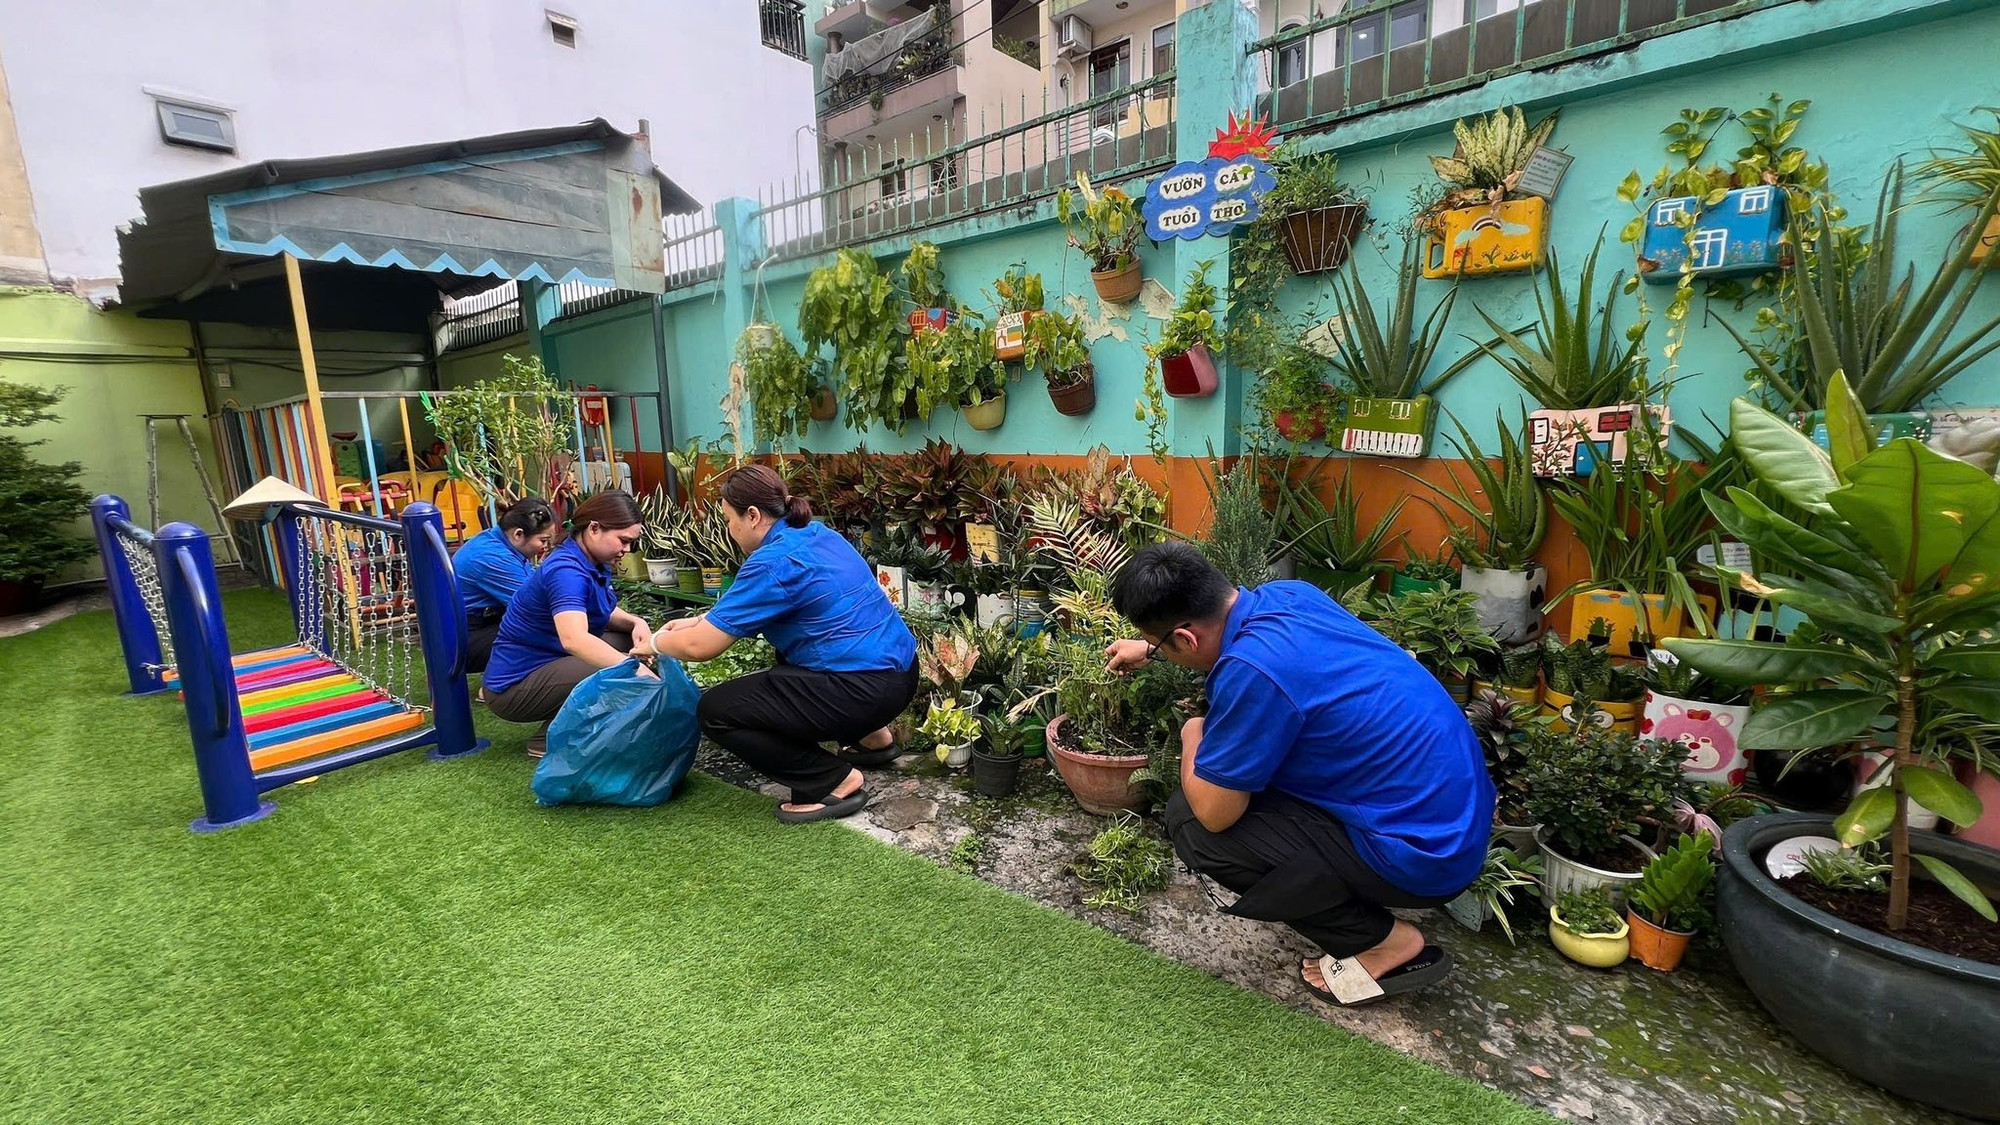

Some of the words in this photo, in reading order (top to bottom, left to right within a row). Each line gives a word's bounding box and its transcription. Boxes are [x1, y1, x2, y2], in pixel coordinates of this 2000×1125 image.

[1163, 177, 1203, 194] VƯỜN
[1163, 207, 1197, 226] TUỔI
[1213, 203, 1244, 218] THƠ
